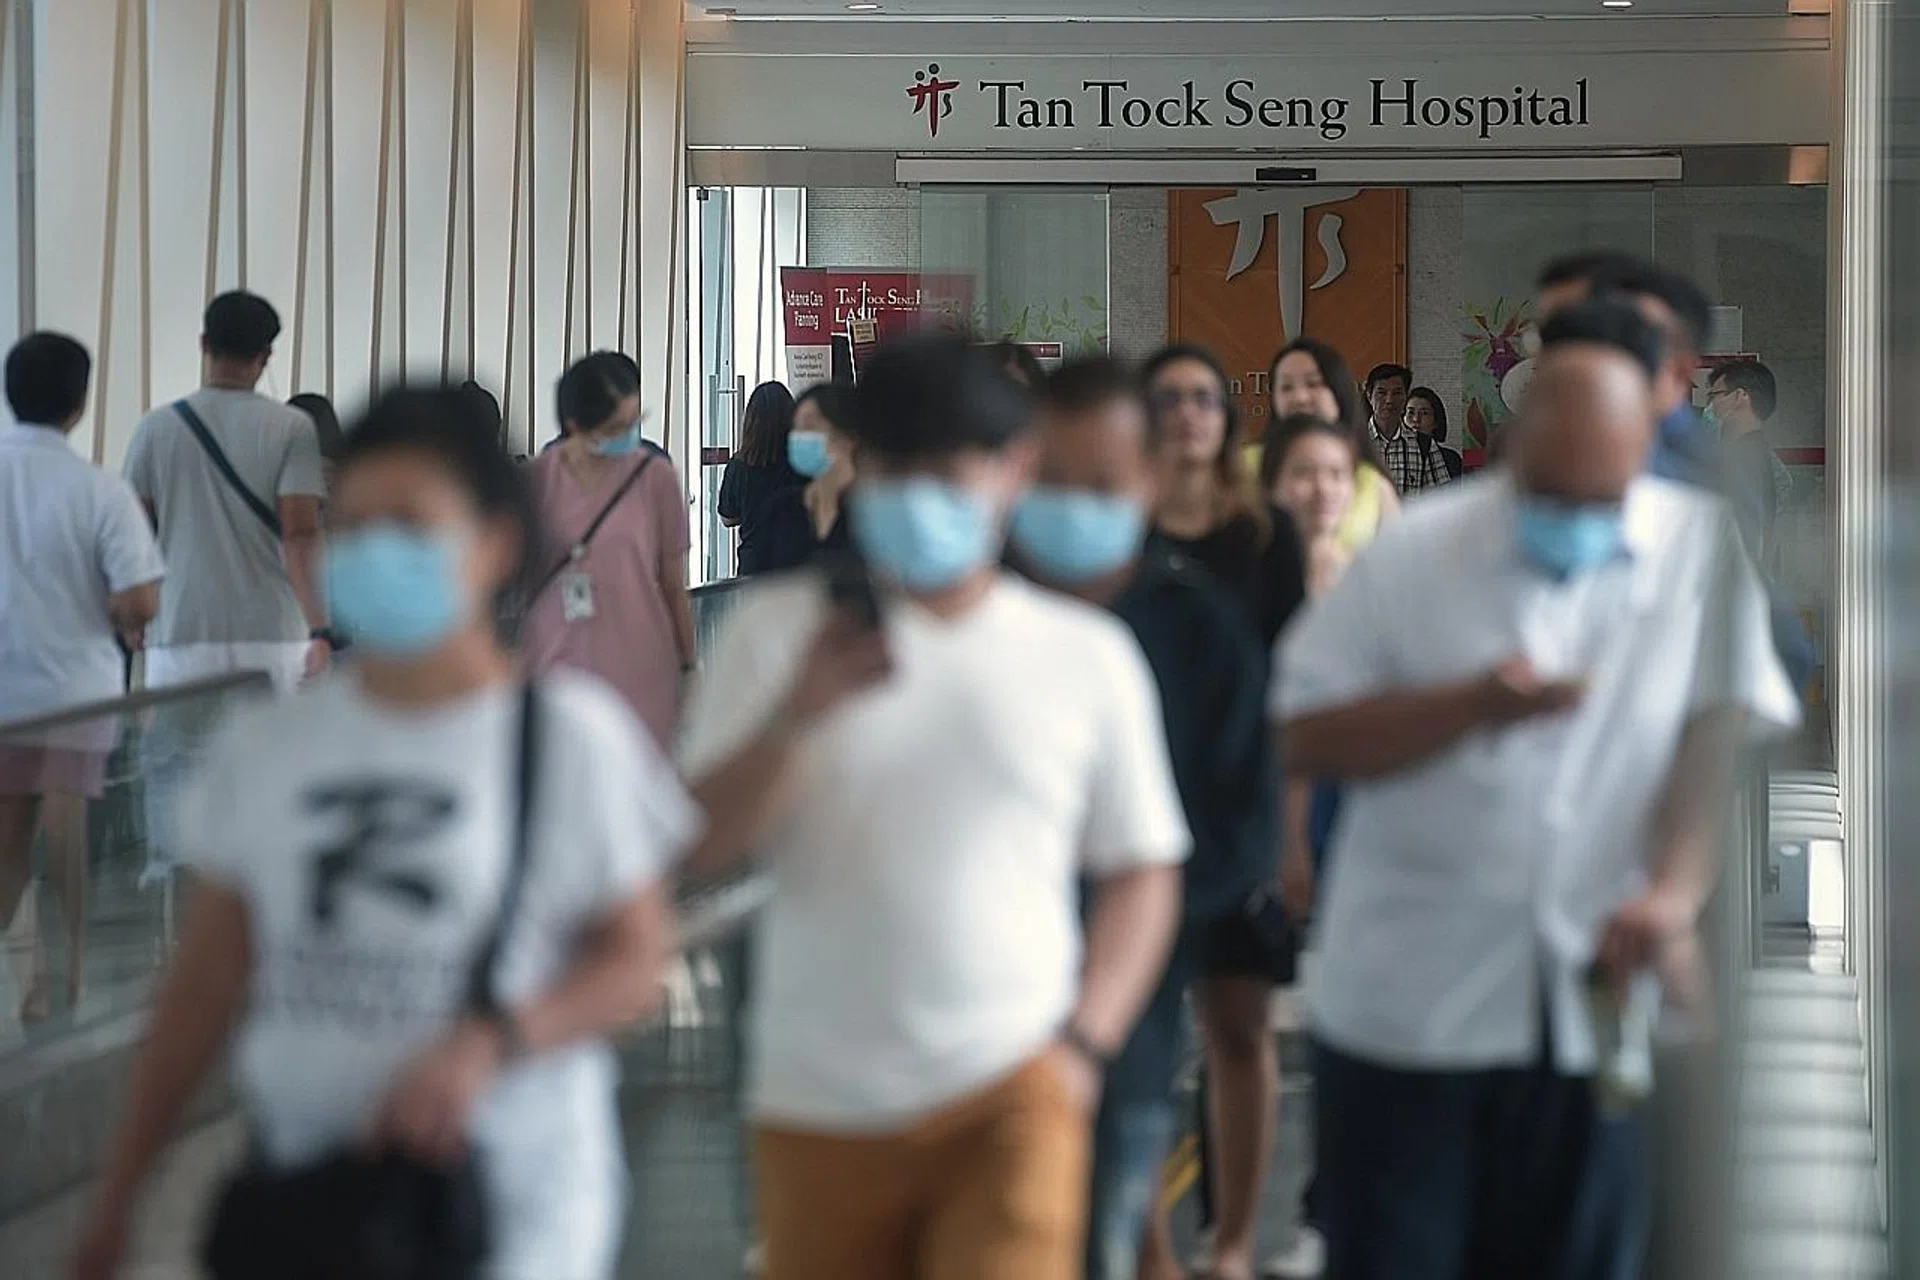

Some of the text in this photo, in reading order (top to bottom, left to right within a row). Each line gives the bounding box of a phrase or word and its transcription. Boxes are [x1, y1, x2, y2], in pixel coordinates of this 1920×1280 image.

[979, 76, 1591, 141] Tan Tock Seng Hospital
